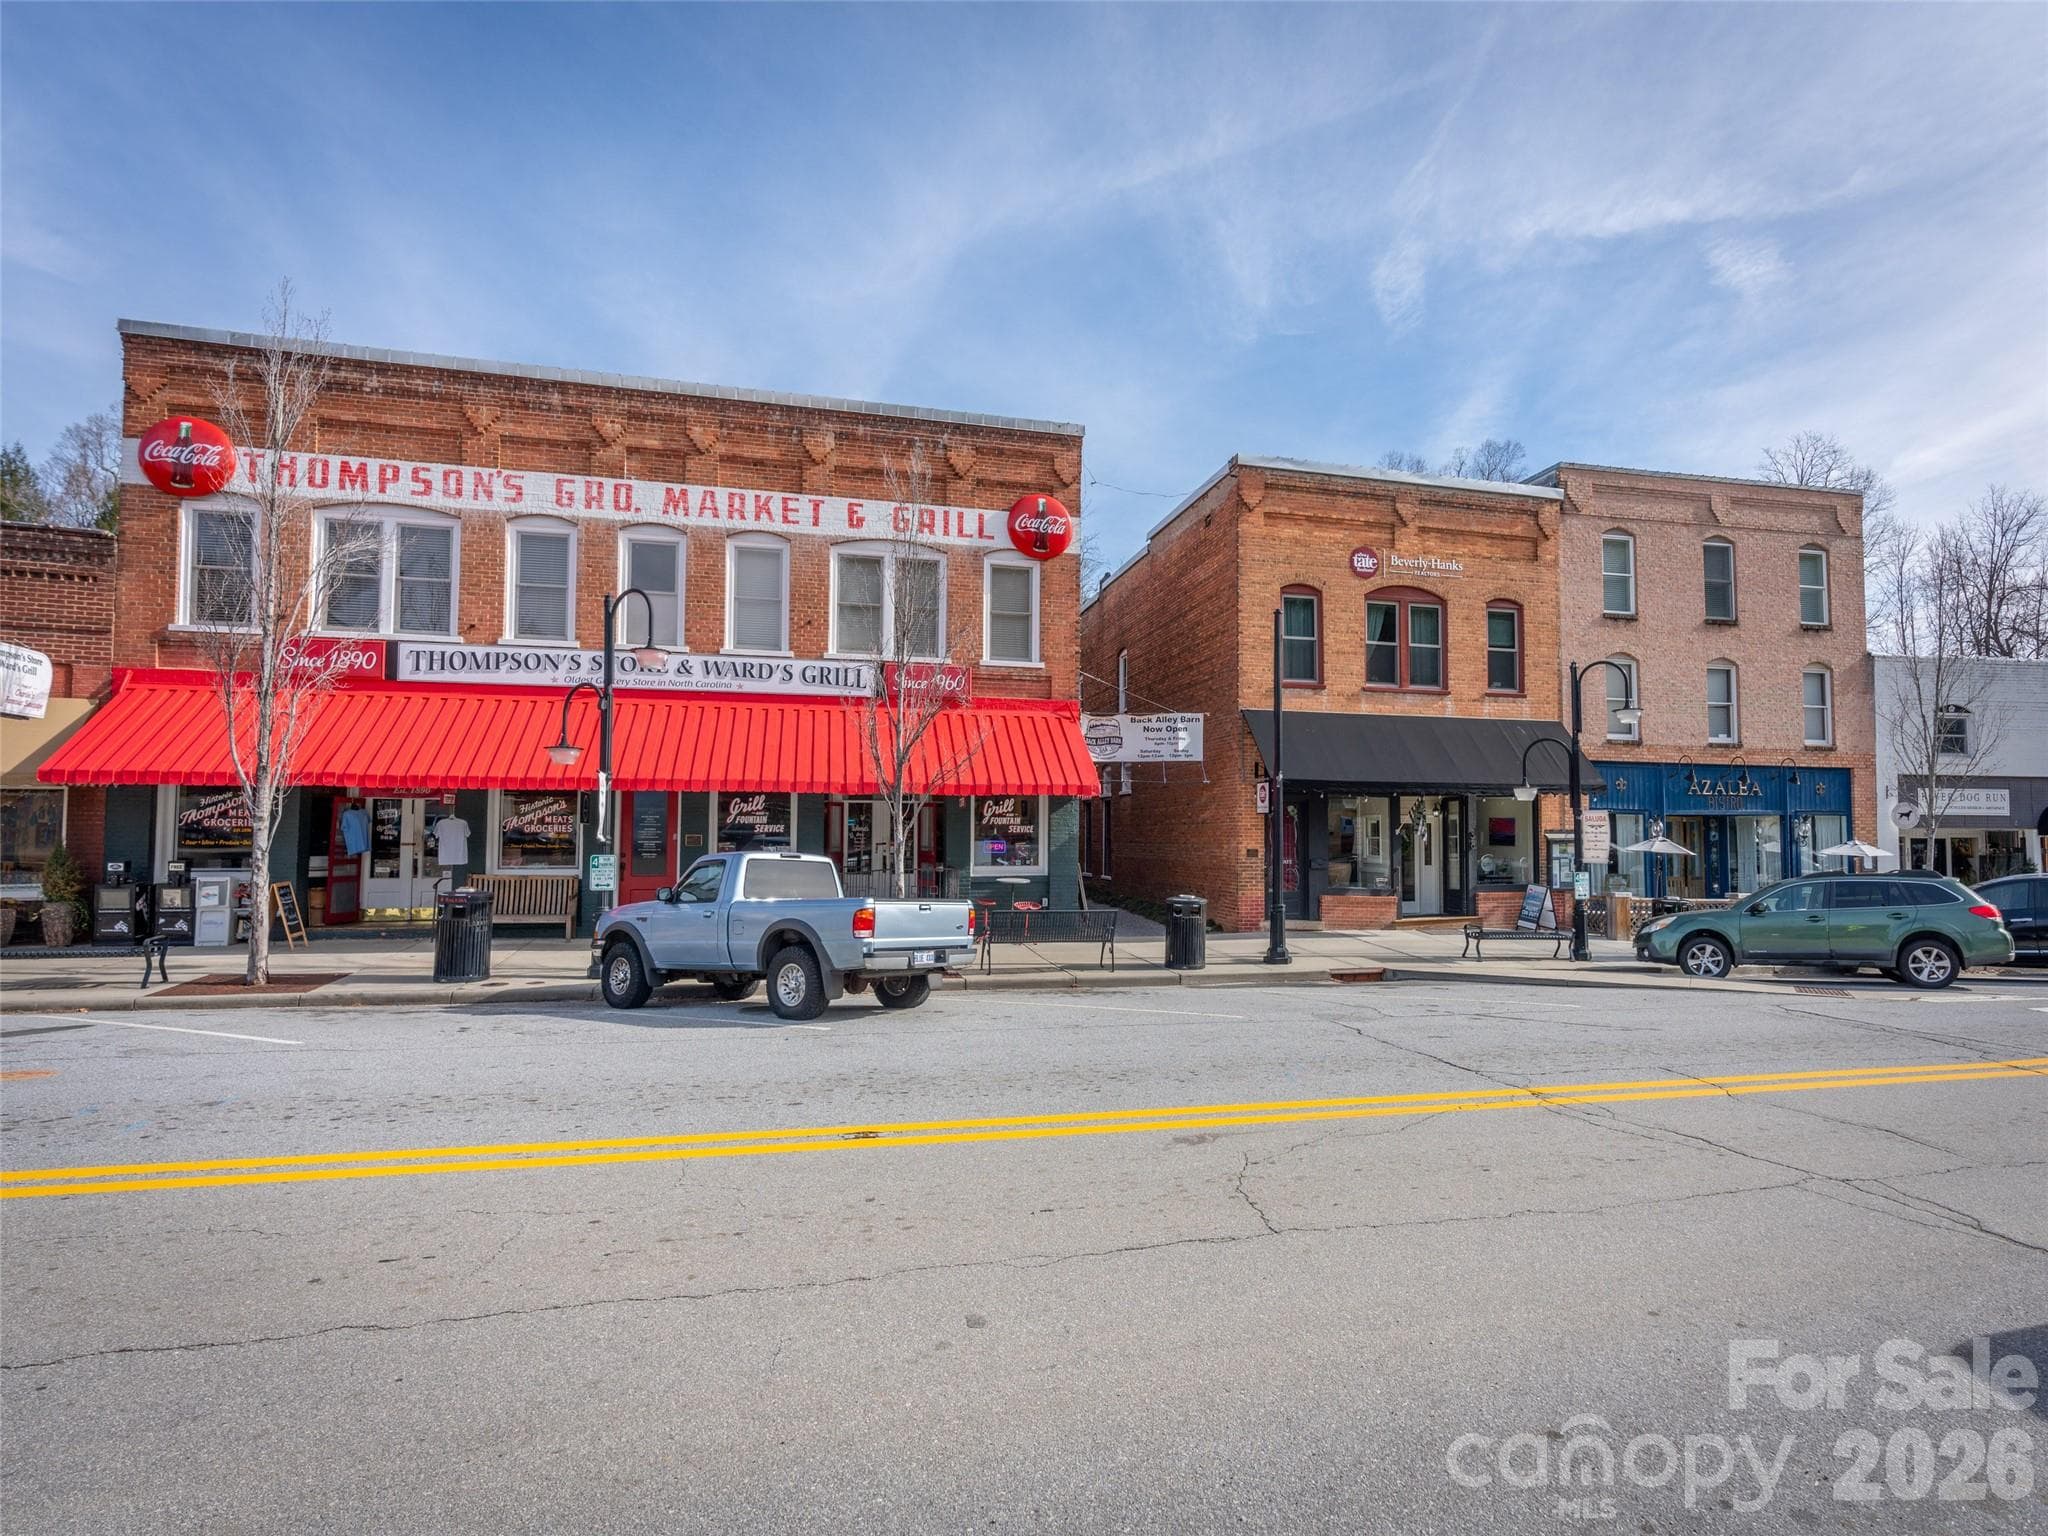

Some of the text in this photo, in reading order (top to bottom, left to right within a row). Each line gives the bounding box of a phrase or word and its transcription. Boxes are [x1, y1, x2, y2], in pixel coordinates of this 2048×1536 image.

[144, 439, 224, 466] Coca-Cola
[243, 451, 995, 540] THOMPSON'S GRO. MARKET & GRILL
[1015, 513, 1067, 535] Coca-Cola
[1391, 554, 1463, 571] Beverly-Hanks
[281, 647, 377, 669] Since 1890
[410, 650, 581, 672] THOMPSON'S
[677, 658, 694, 675] &
[703, 660, 793, 682] WARD'S
[802, 665, 867, 689] GRILL
[564, 675, 593, 685] Oldest
[632, 677, 656, 686] Store
[695, 680, 732, 688] Carolina
[892, 671, 928, 691] Since
[1130, 716, 1153, 724] Back
[1155, 716, 1178, 725] Alley
[1143, 725, 1188, 734] Now Open
[1688, 779, 1763, 796] AZALEA
[1960, 792, 1980, 802] DOG
[1986, 792, 2006, 802] RUN
[503, 800, 567, 831] Thompson's
[727, 794, 766, 823] Grill
[982, 798, 1015, 824] Grill
[544, 815, 573, 824] MEATS
[735, 815, 768, 824] FOUNTAIN
[989, 816, 1021, 825] FOUNTAIN
[524, 824, 573, 833] GROCERIES
[753, 824, 784, 833] SERVICE
[1007, 825, 1034, 833] SERVICE
